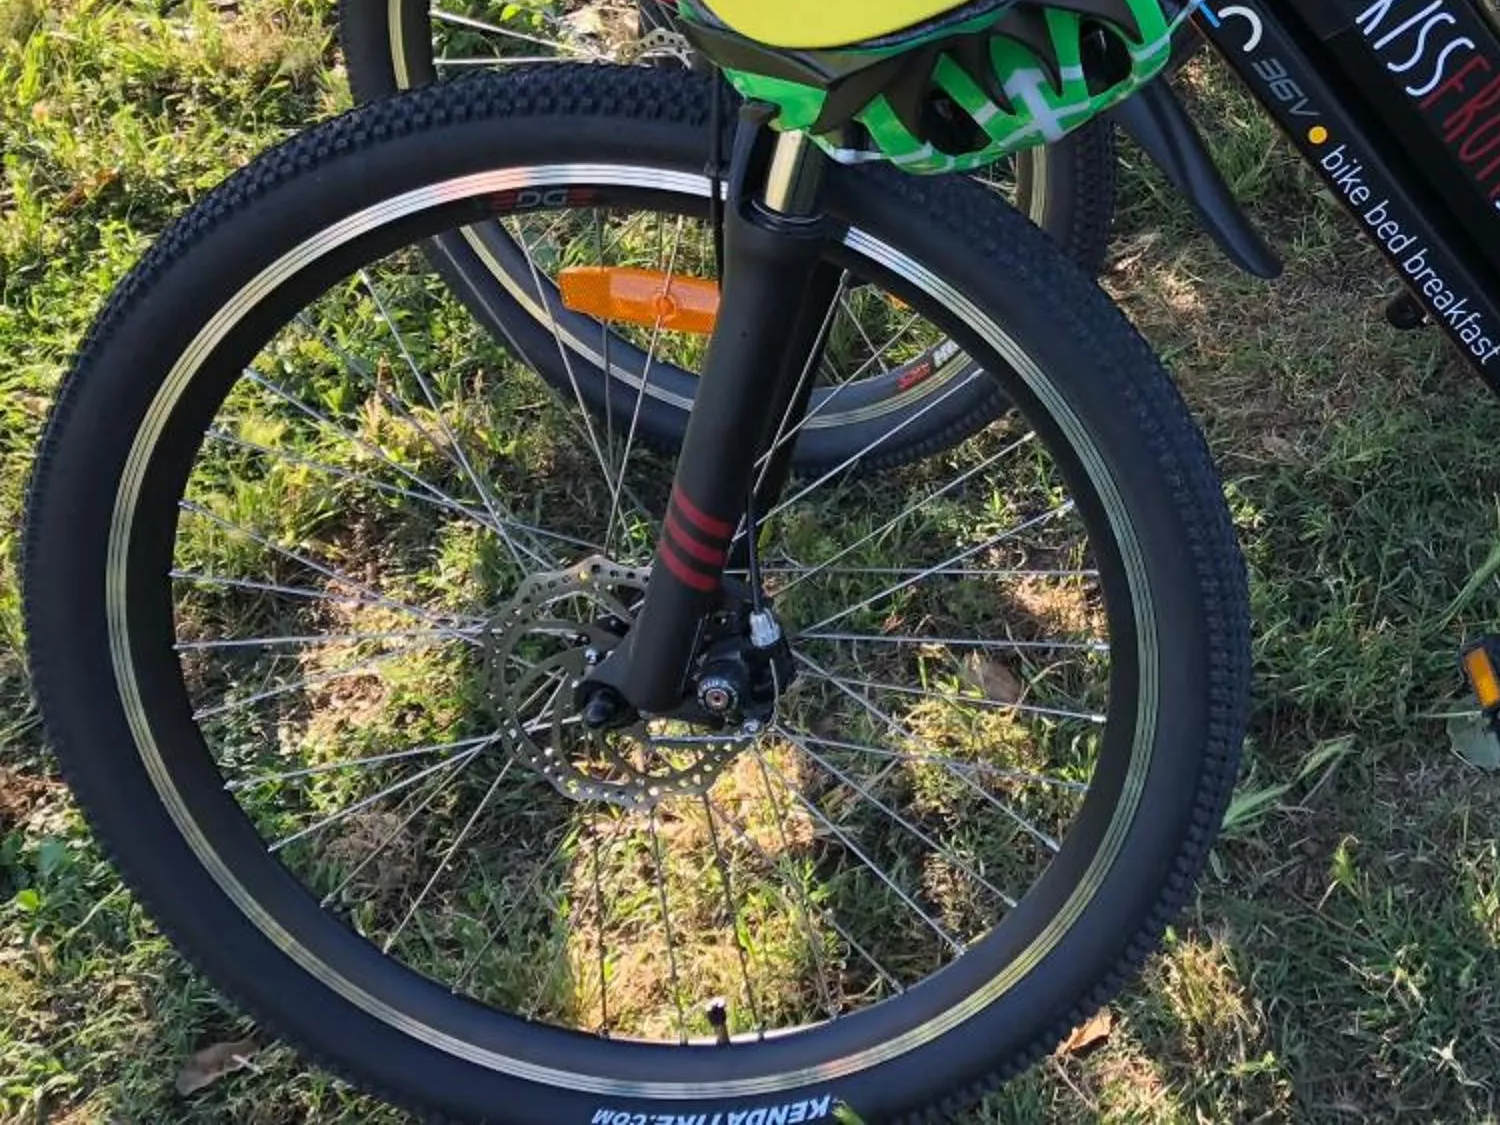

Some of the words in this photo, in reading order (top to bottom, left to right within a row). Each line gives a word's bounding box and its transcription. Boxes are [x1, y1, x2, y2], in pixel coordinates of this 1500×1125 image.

[1250, 57, 1322, 116] 36V
[1320, 144, 1370, 206] bike
[1363, 199, 1418, 255] bed
